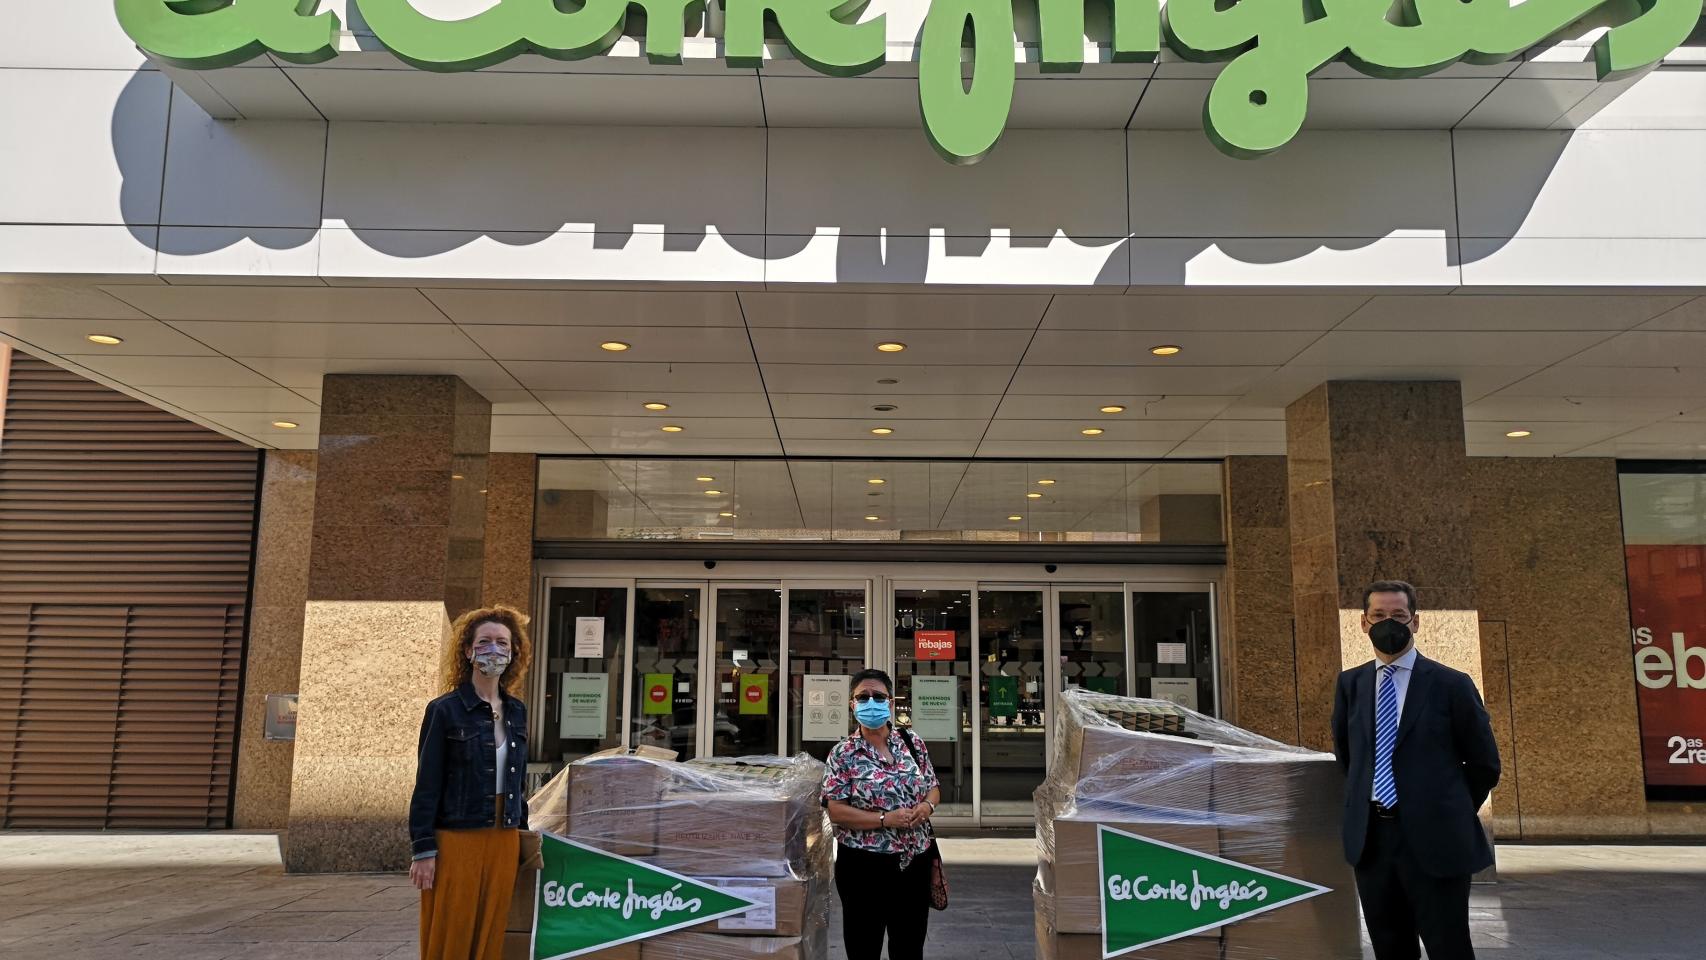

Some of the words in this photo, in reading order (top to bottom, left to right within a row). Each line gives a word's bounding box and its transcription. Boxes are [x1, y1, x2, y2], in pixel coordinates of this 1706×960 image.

[918, 639, 953, 650] rebajas
[543, 880, 566, 907] El
[567, 882, 621, 909] Corte
[622, 878, 702, 920] Inglés
[1107, 874, 1132, 901] El
[1132, 875, 1188, 901] Corte
[1190, 869, 1268, 911] Inglés
